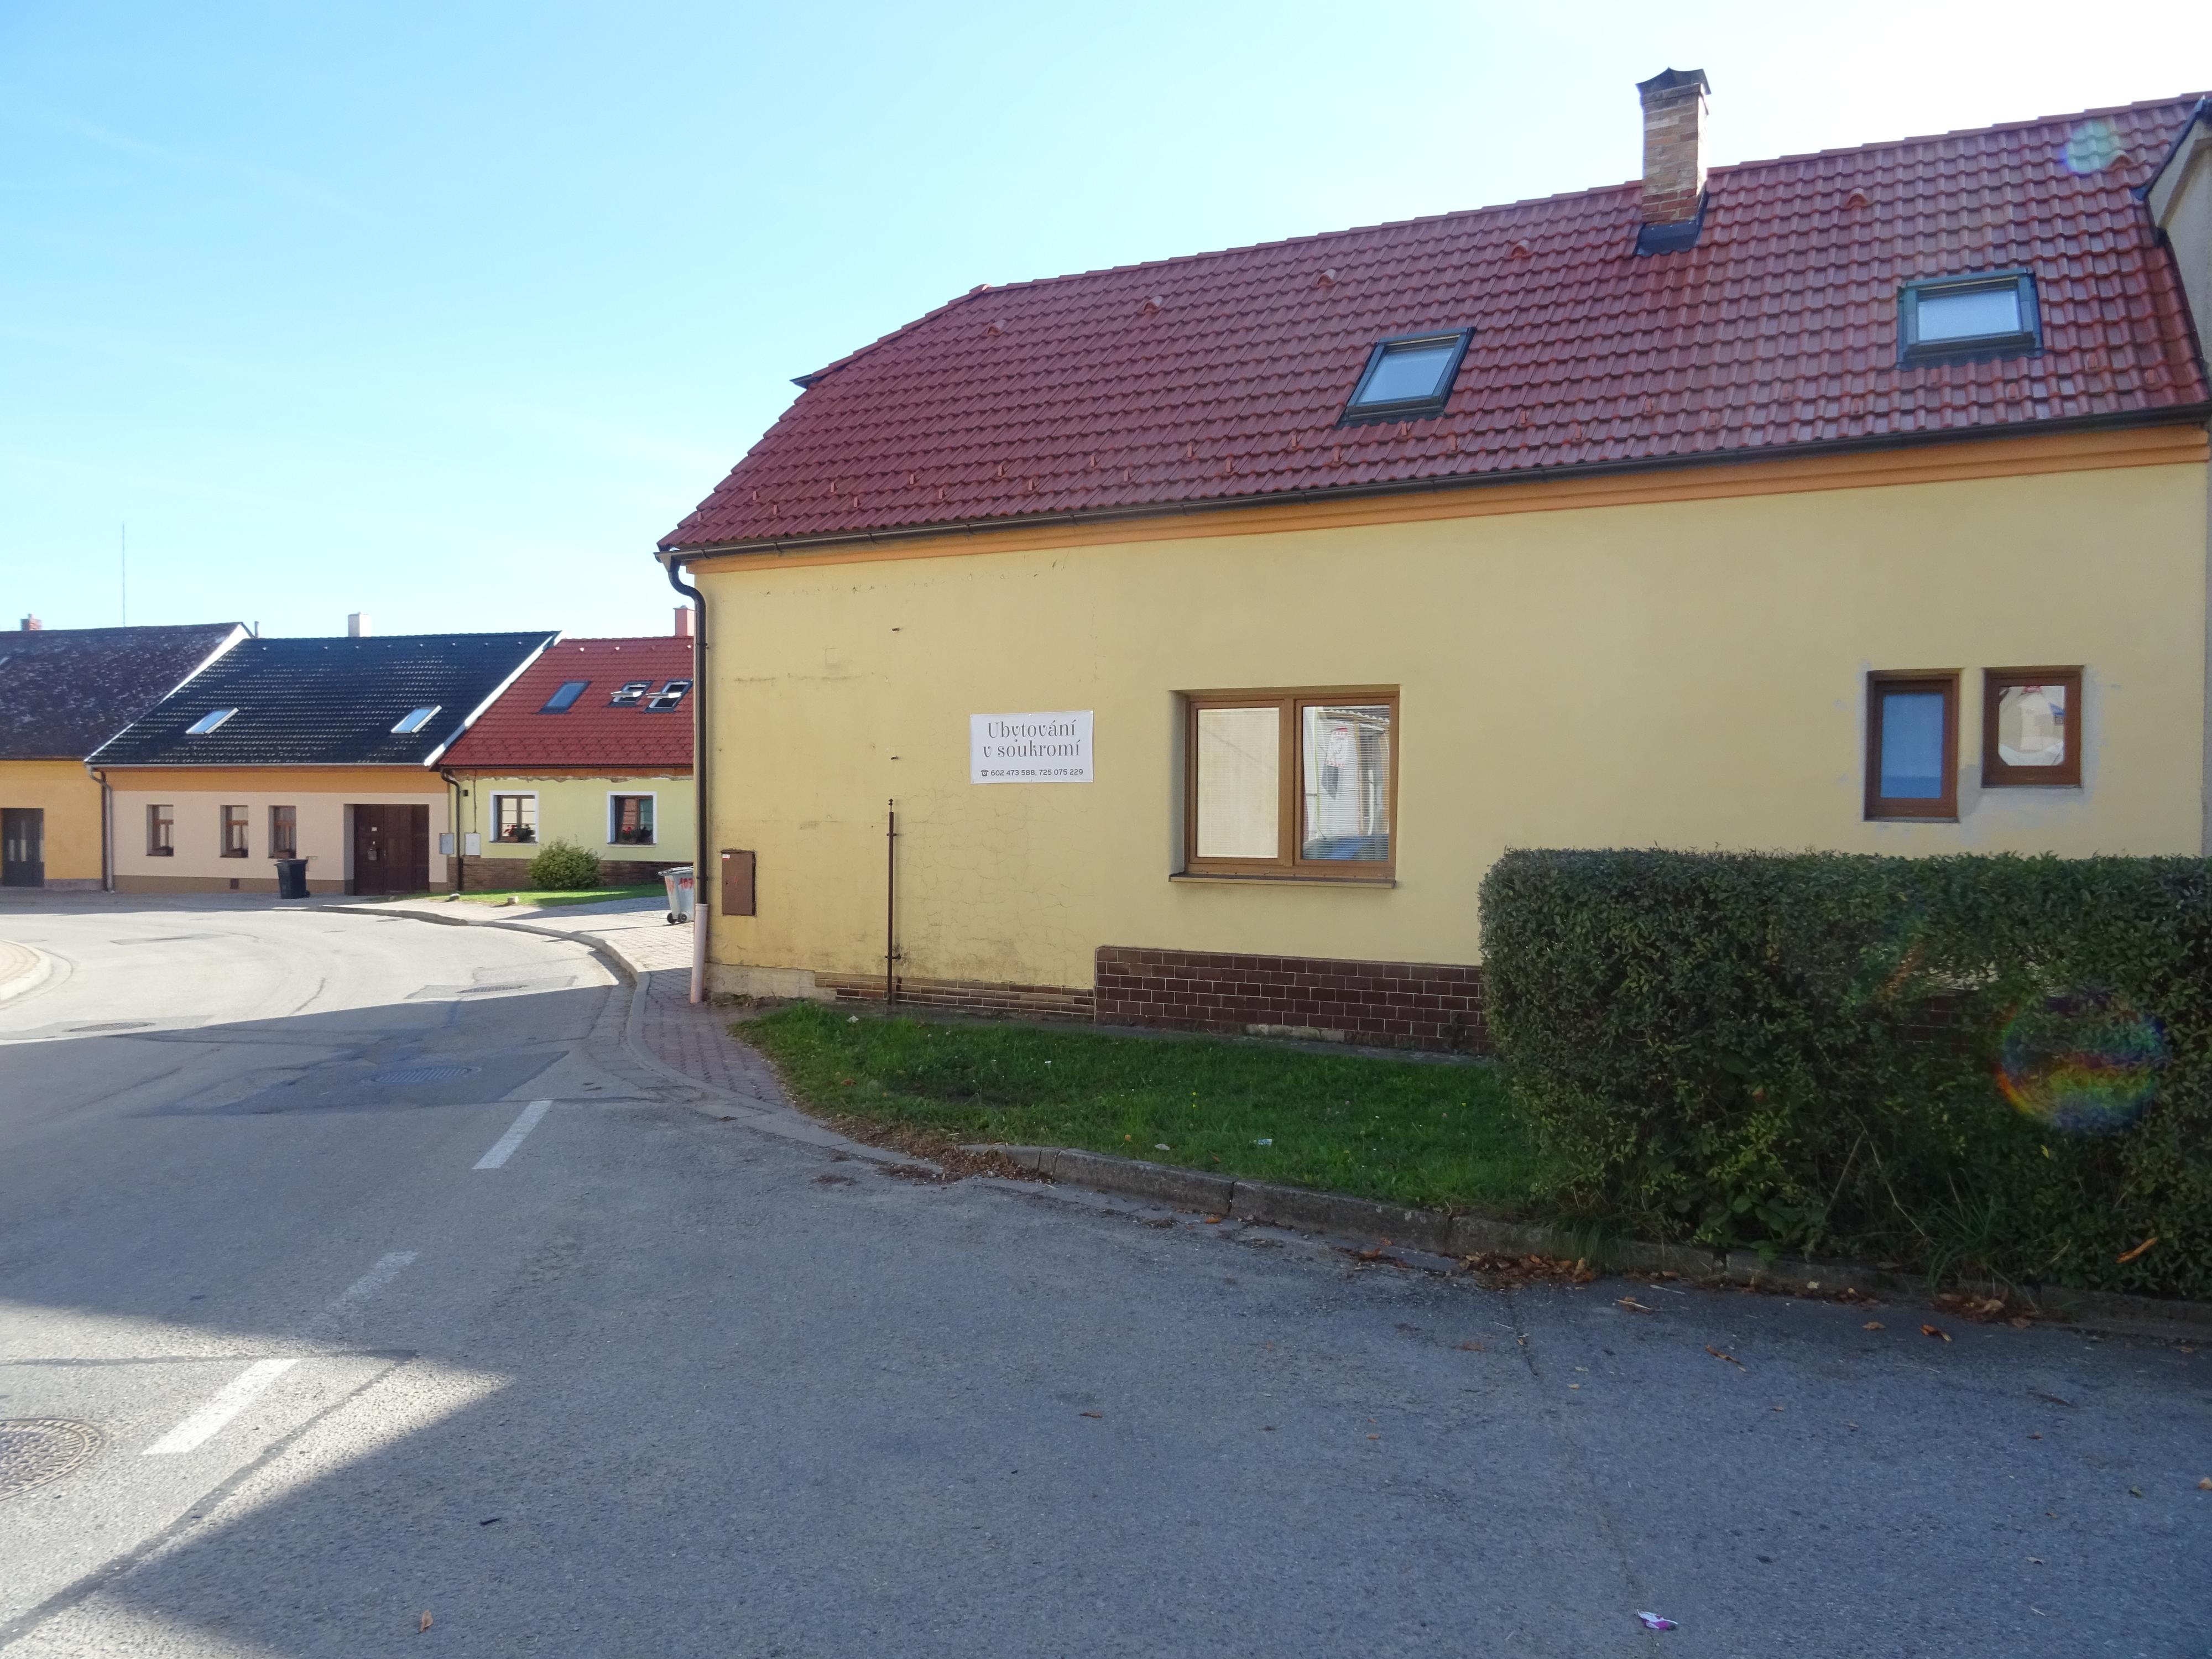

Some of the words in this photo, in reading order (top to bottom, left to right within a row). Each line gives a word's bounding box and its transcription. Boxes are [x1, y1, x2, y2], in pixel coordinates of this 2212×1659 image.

[987, 719, 1077, 742] Ubytování
[983, 746, 992, 758] v
[997, 739, 1081, 758] soukromí
